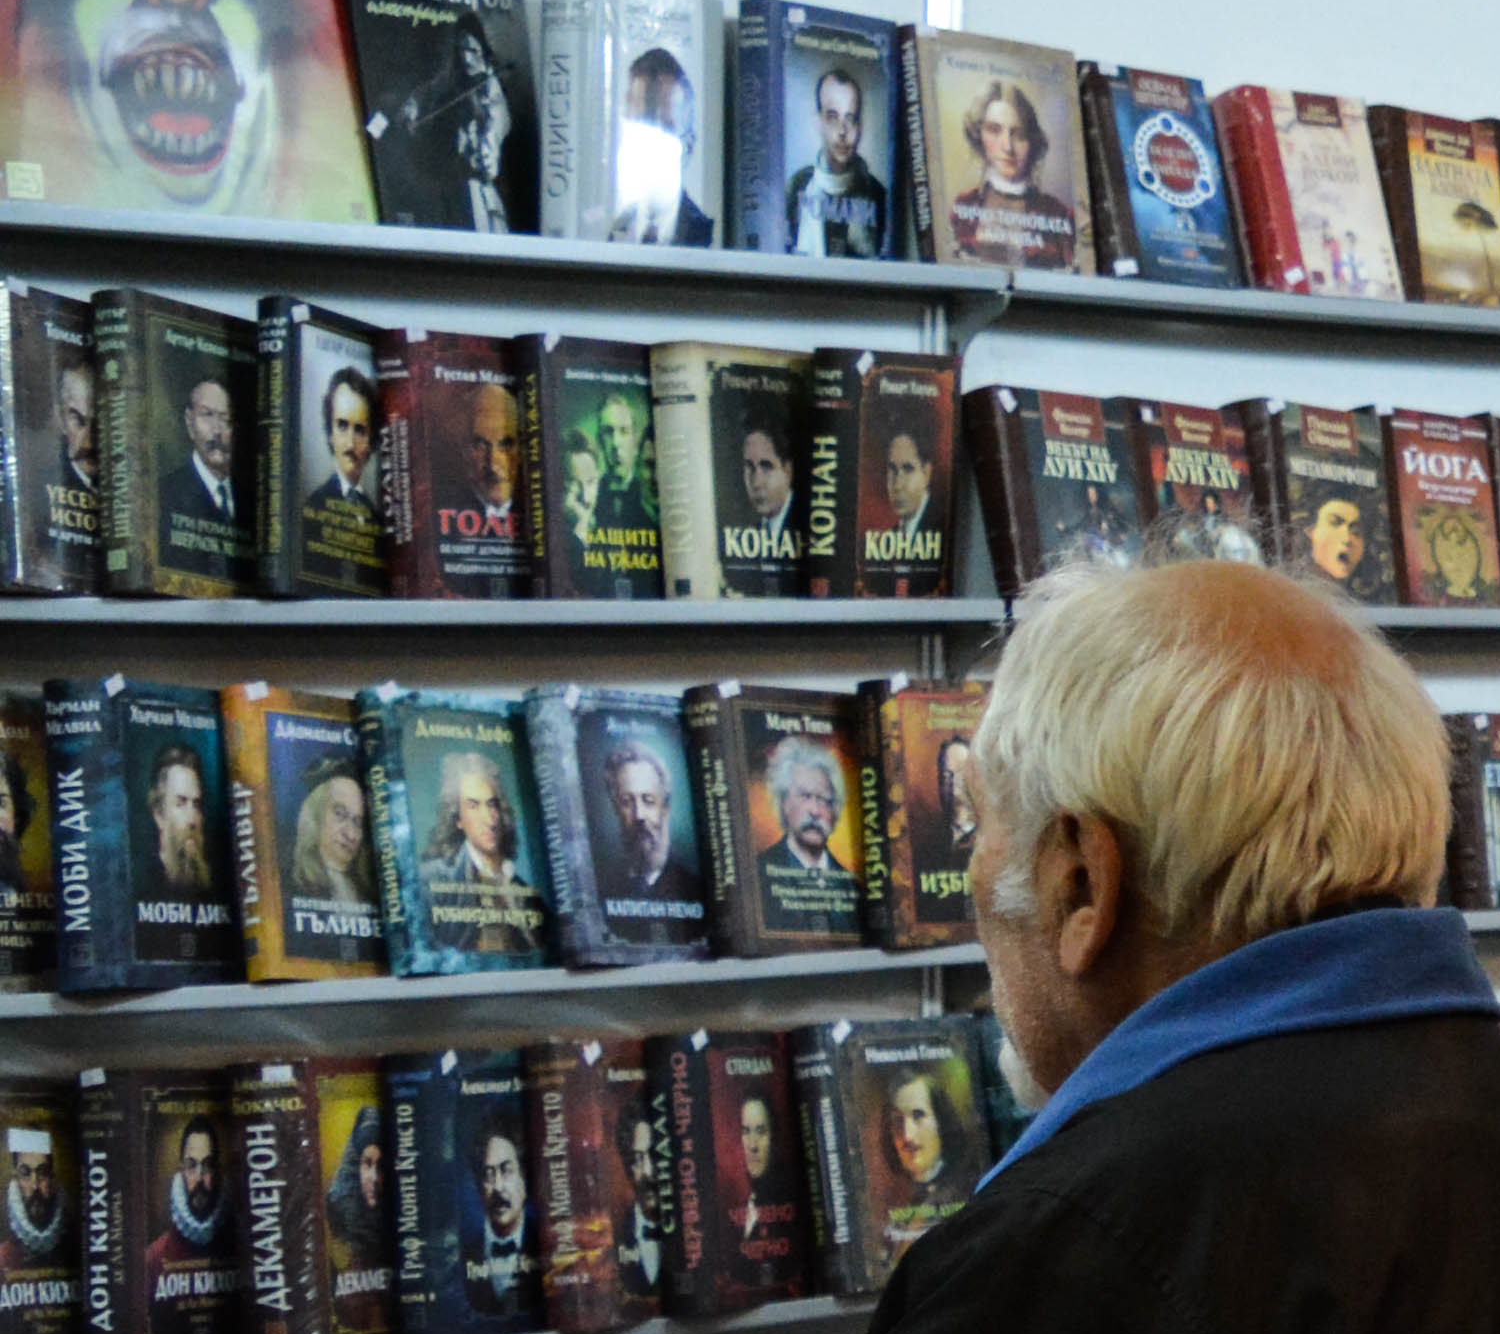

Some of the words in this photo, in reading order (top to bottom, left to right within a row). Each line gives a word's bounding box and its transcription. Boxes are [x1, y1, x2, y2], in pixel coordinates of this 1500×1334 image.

[434, 365, 477, 384] Густав
[1042, 454, 1084, 481] ЛУИ
[1085, 459, 1120, 484] XIV
[1165, 460, 1206, 486] ЛУИ
[1207, 465, 1242, 491] XIV
[1402, 444, 1489, 484] ЙОГА
[51, 508, 97, 531] ИСТО
[808, 434, 838, 557] КОНАН
[438, 508, 520, 538] ГОЛЕ
[864, 530, 942, 561] КОНАН
[57, 766, 89, 834] ДИК
[231, 778, 259, 928] ГЪЛИВЕР
[860, 766, 890, 900] ИЗБРАНО
[62, 839, 92, 932] МОБИ
[606, 899, 671, 919] КАПИТАН
[137, 902, 192, 925] МОБИ
[194, 903, 231, 927] ДИК
[293, 911, 384, 939] ГЪЛИВЕ
[670, 1051, 694, 1137] ЧЕРНО
[395, 1103, 415, 1171] Кристо
[543, 1090, 568, 1161] Кристо
[87, 1148, 111, 1256] КИХОТ
[246, 1122, 293, 1312] ДЕКАМЕРОН
[397, 1174, 419, 1234] Монте
[548, 1165, 571, 1217] Монте
[676, 1158, 704, 1271] ЧЕРВЕНО
[38, 1279, 80, 1305] КИХО
[89, 1263, 116, 1333] ДОН
[155, 1271, 191, 1302] ДОН
[193, 1269, 237, 1294] КИХО
[335, 1269, 391, 1297] ДЕКАМЕ
